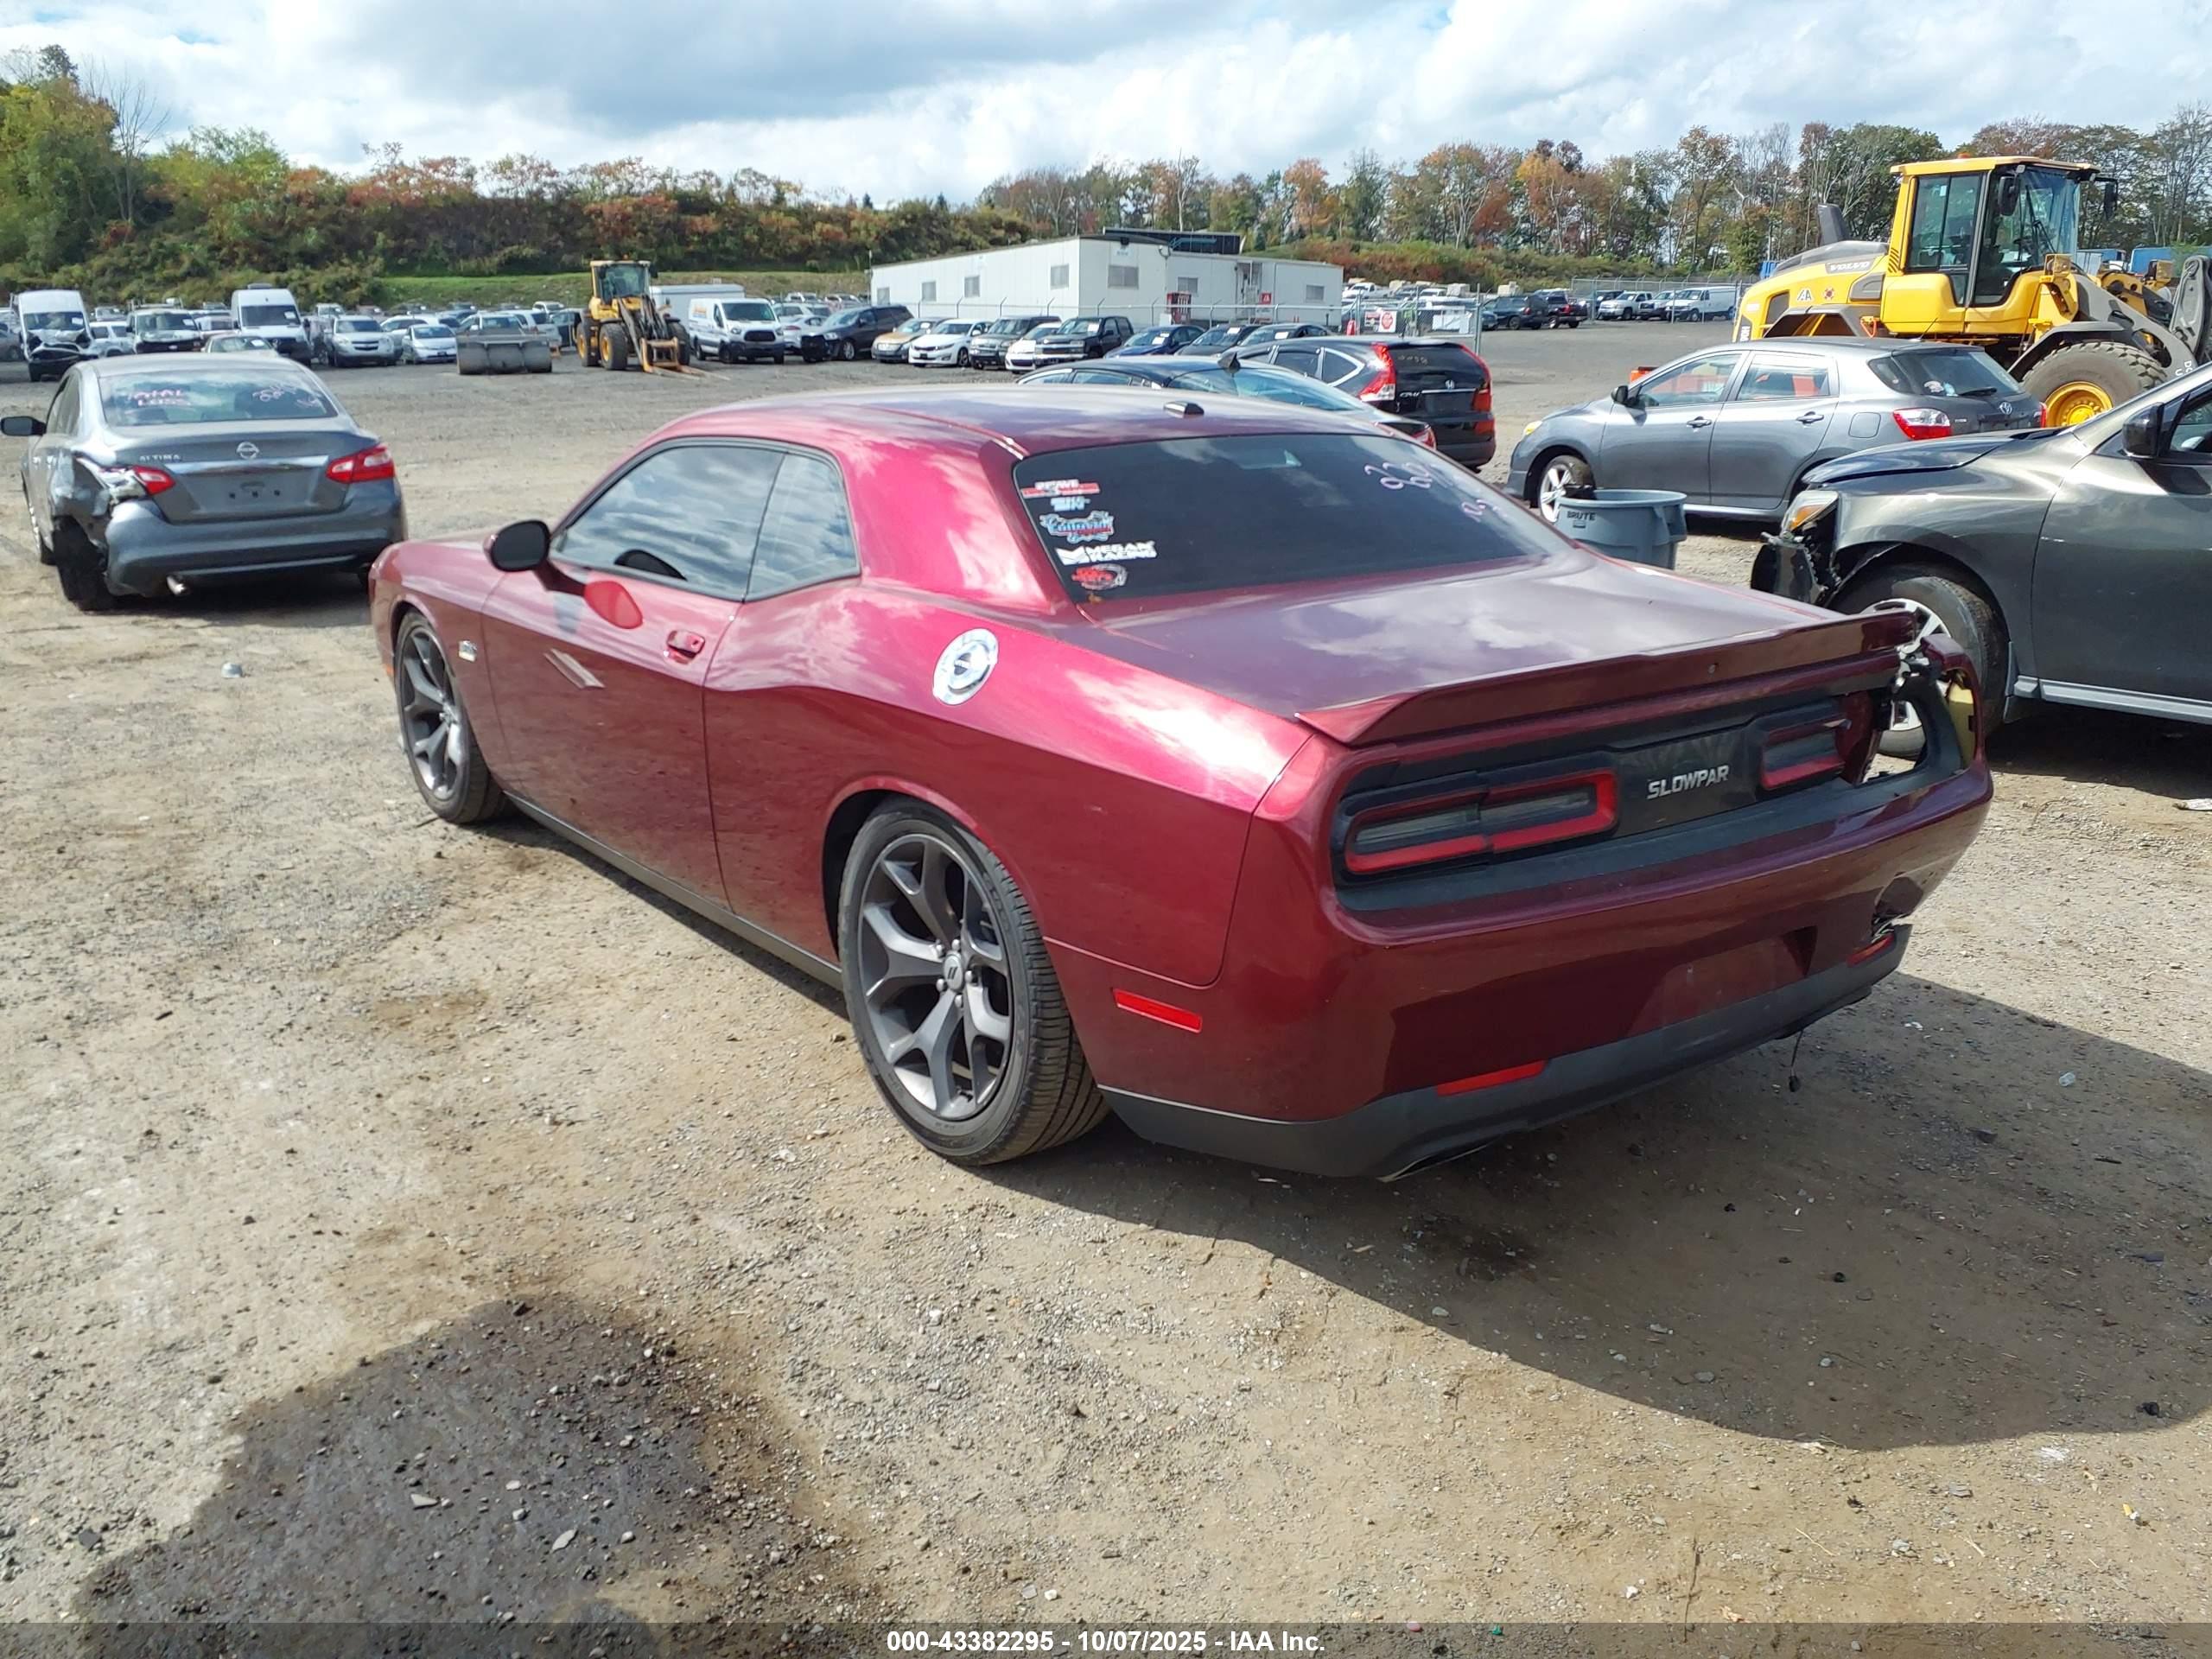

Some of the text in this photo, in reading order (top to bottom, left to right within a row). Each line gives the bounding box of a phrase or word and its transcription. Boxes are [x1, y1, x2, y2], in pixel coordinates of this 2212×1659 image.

[1829, 261, 1871, 271] VOLVO
[138, 454, 181, 462] ALTIMA
[1566, 510, 1597, 522] BRUTE
[1646, 765, 1729, 800] SLOWPAR
